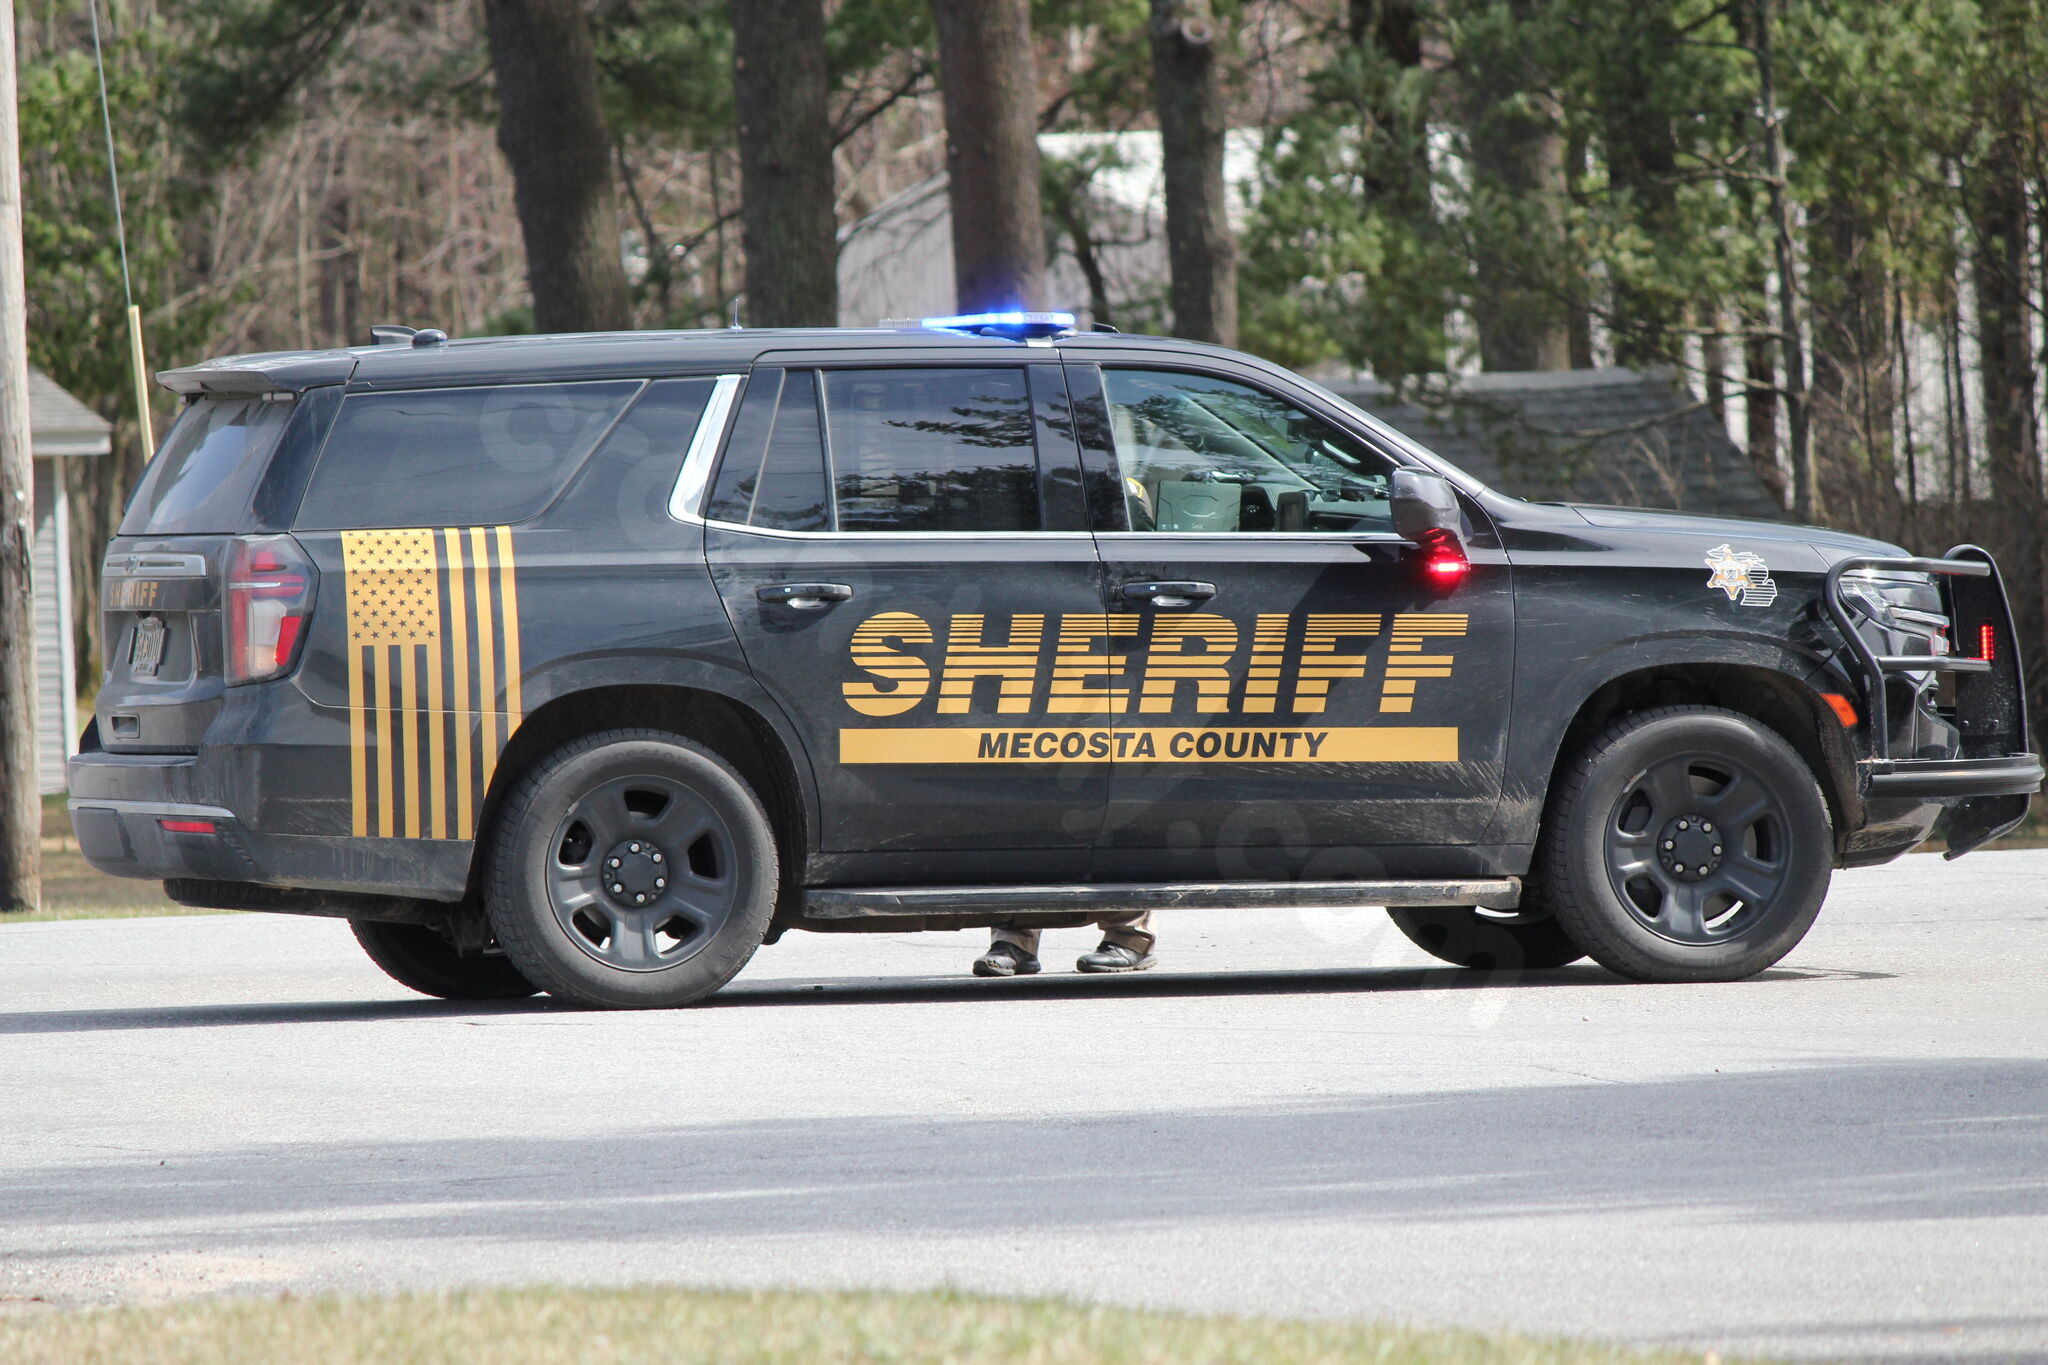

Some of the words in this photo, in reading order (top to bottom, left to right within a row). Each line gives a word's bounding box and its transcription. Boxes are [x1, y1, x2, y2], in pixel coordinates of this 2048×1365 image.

[110, 581, 160, 607] SHERIFF
[842, 611, 1469, 717] SHERIFF
[978, 731, 1155, 759] MECOSTA
[1169, 731, 1328, 759] COUNTY
